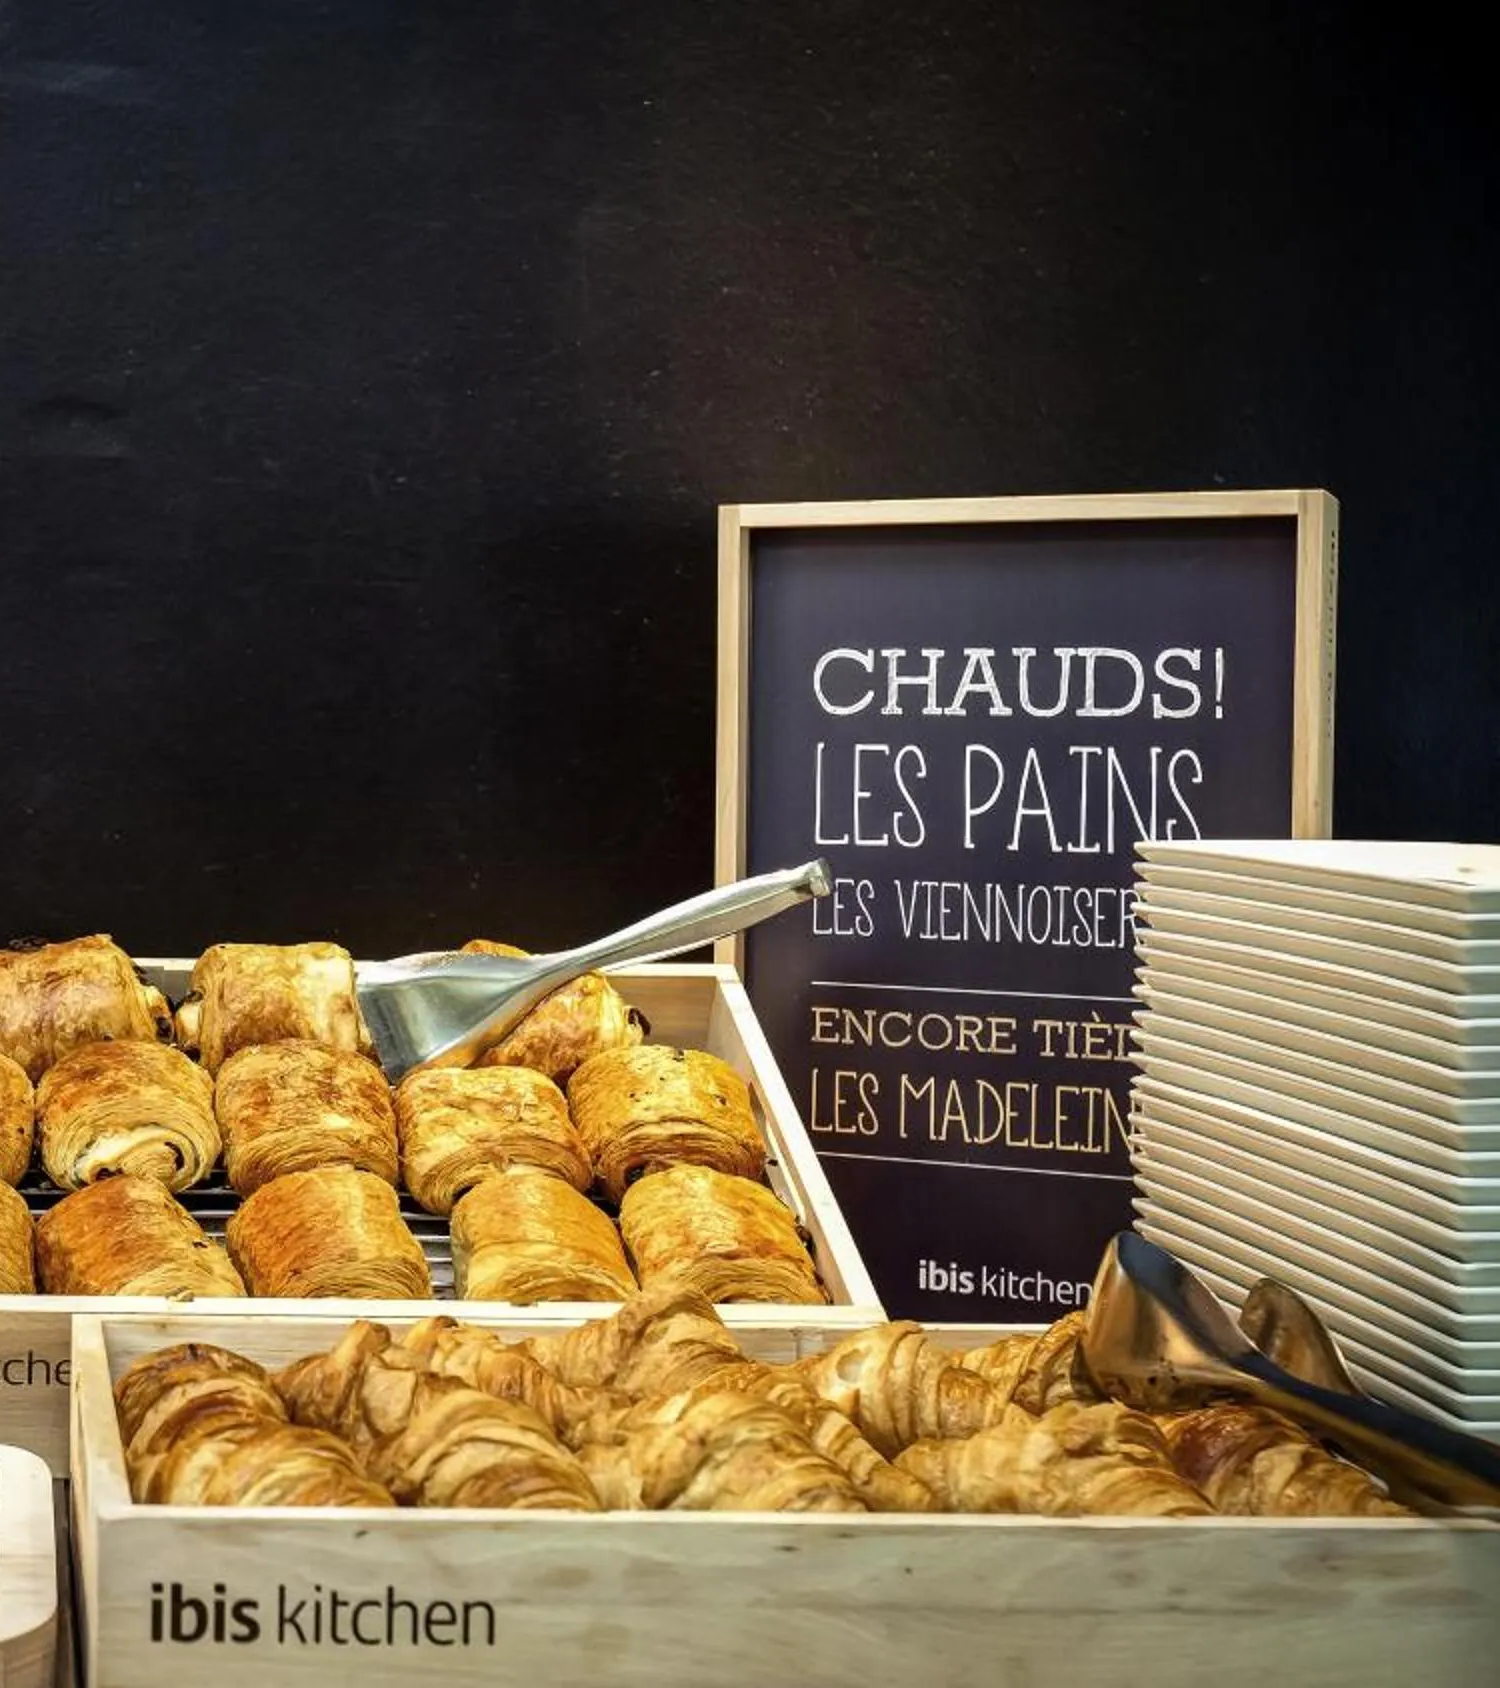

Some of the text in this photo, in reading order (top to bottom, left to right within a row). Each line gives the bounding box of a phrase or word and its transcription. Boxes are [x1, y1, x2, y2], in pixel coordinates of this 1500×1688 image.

[813, 647, 1224, 719] CHAUDS!
[814, 742, 1203, 854] LES PAINS
[812, 877, 875, 937] LES
[811, 1007, 1017, 1055] ENCORE
[811, 1067, 1136, 1154] LES MADELEIN
[919, 1259, 1094, 1306] ibis kitchen
[150, 1583, 496, 1647] ibis kitchen
